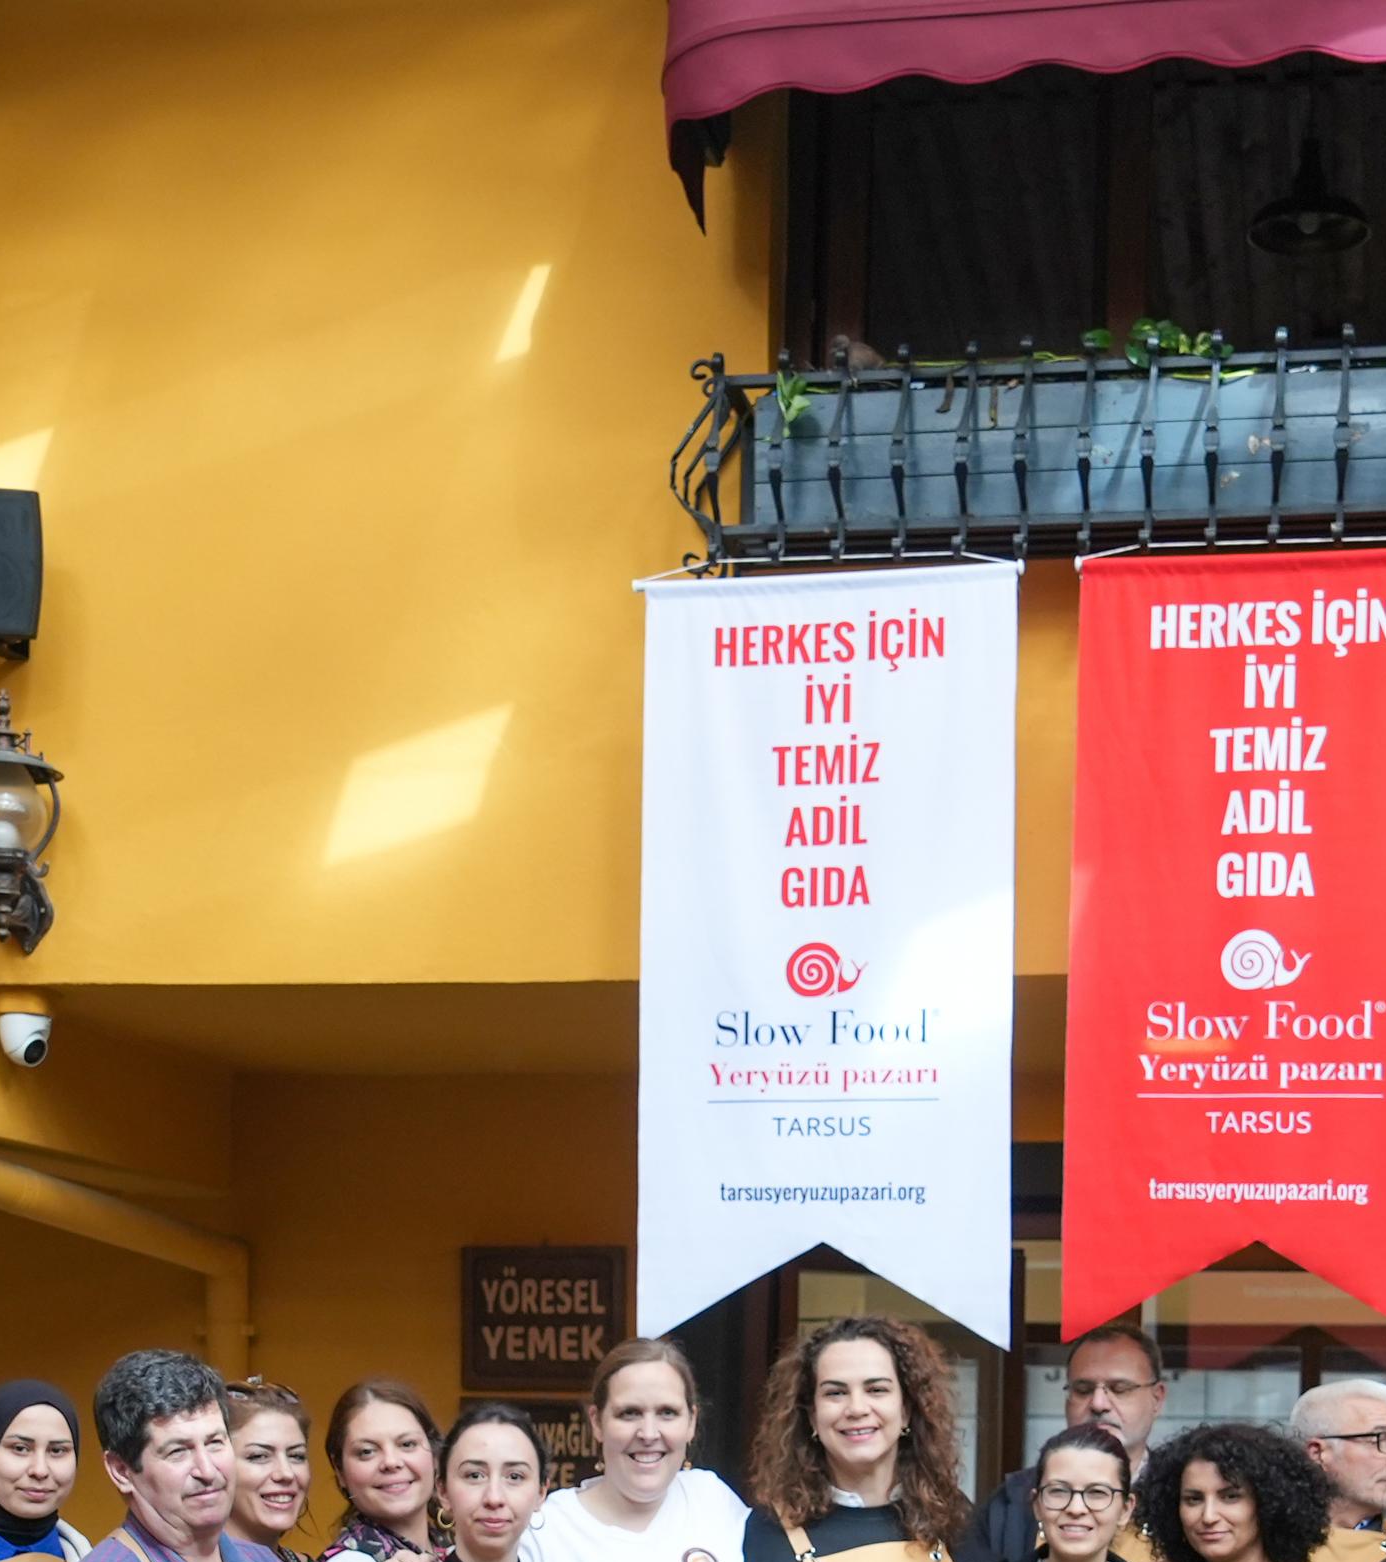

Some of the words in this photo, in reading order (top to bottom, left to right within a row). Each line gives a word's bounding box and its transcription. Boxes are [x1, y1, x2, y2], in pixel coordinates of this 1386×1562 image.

[713, 620, 856, 668] HERKES
[867, 607, 946, 669] İÇİN
[1148, 601, 1301, 650] HERKES
[804, 673, 853, 725] İYİ
[1242, 654, 1297, 709] İYİ
[772, 734, 881, 787] TEMİZ
[1209, 716, 1327, 773] TEMİZ
[784, 797, 868, 847] ADİL
[1220, 779, 1312, 836] ADİL
[780, 865, 870, 908] GIDA
[1215, 851, 1315, 899] GIDA
[714, 1013, 811, 1049] Slow
[1146, 1003, 1250, 1041] Slow
[707, 1062, 831, 1093] Yeryüzü
[841, 1064, 939, 1092] pazarı
[1137, 1054, 1269, 1091] Yeryüzü
[1279, 1055, 1385, 1090] pazarı
[772, 1116, 872, 1138] TARSUS
[1206, 1110, 1312, 1135] TARSUS
[719, 1180, 926, 1205] tarsusyeryuzupazari.org
[1148, 1177, 1369, 1205] tarsusyeryuzupazari.org
[481, 1266, 607, 1315] YÖRESEL
[481, 1325, 605, 1361] YEMEK
